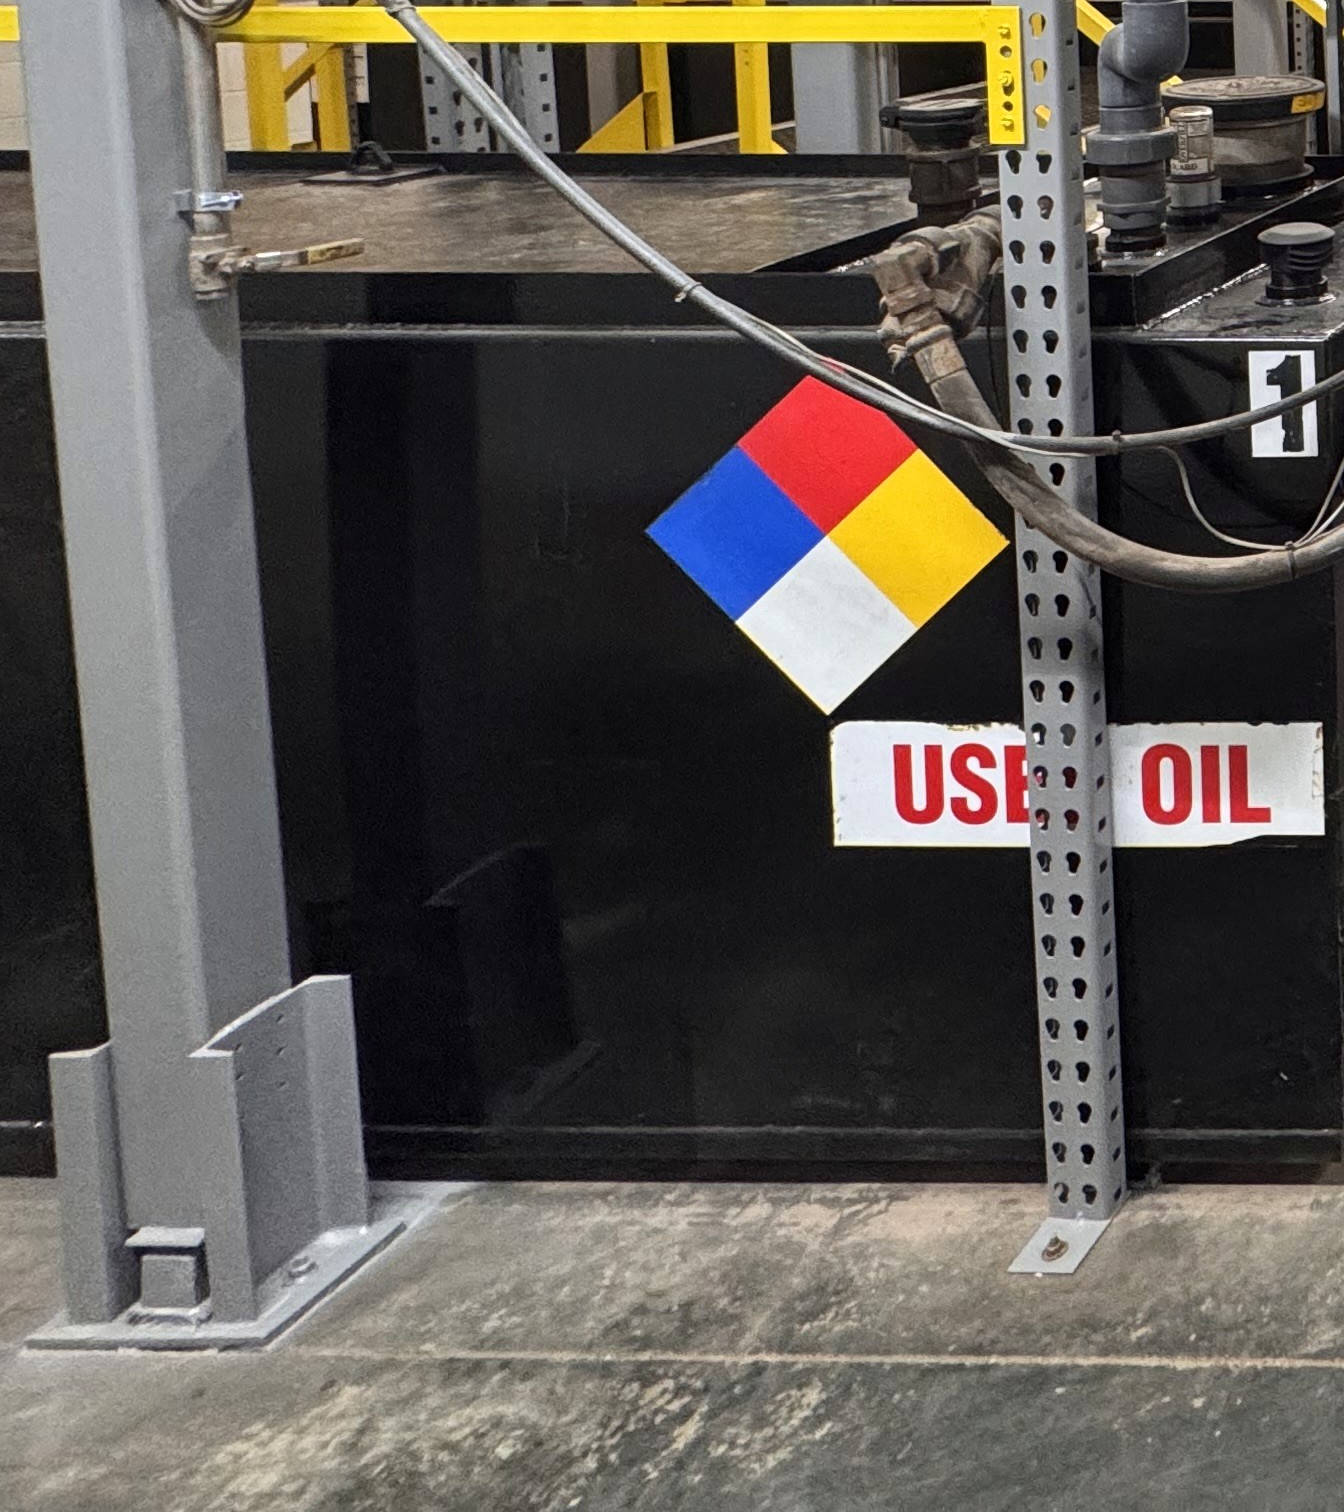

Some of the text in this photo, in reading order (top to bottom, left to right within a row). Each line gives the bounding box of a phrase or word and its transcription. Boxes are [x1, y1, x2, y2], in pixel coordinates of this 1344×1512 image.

[1265, 354, 1309, 455] 1
[892, 742, 1272, 826] USE OIL
